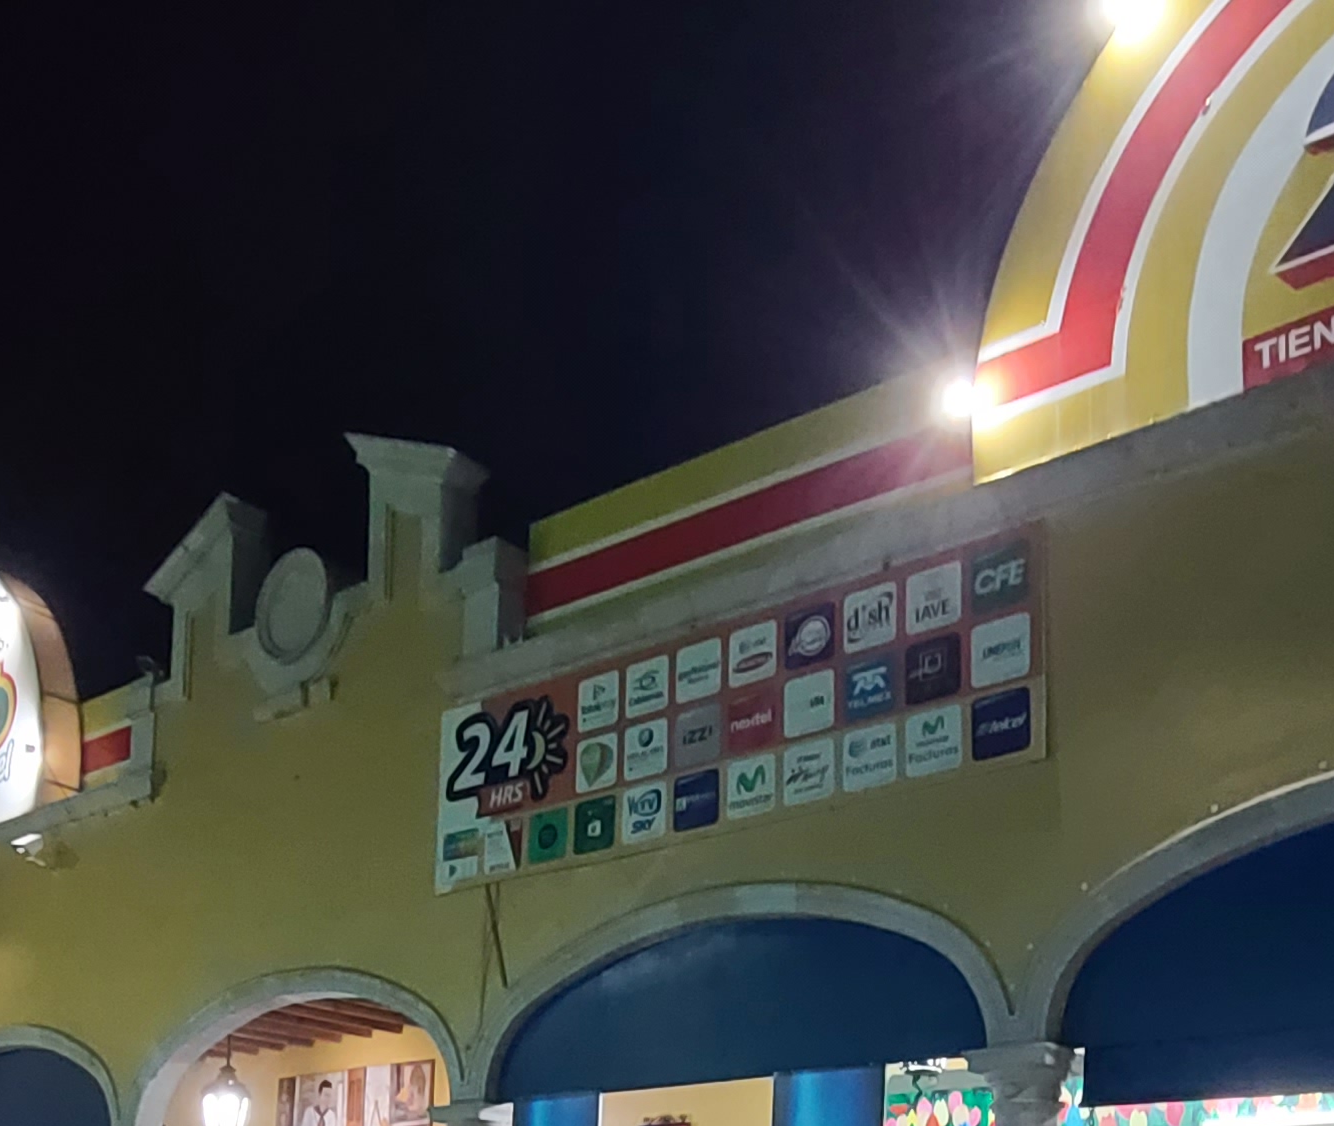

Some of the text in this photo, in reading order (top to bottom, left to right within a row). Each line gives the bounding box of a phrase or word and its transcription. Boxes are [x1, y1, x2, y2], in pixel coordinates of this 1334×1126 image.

[974, 558, 1026, 596] CFE
[915, 599, 950, 623] IAVE
[730, 707, 773, 733] nextel
[451, 706, 531, 794] 24
[908, 744, 959, 765] Facturas
[845, 757, 894, 777] Facturas
[489, 781, 524, 808] HRS
[729, 792, 773, 811] movistar
